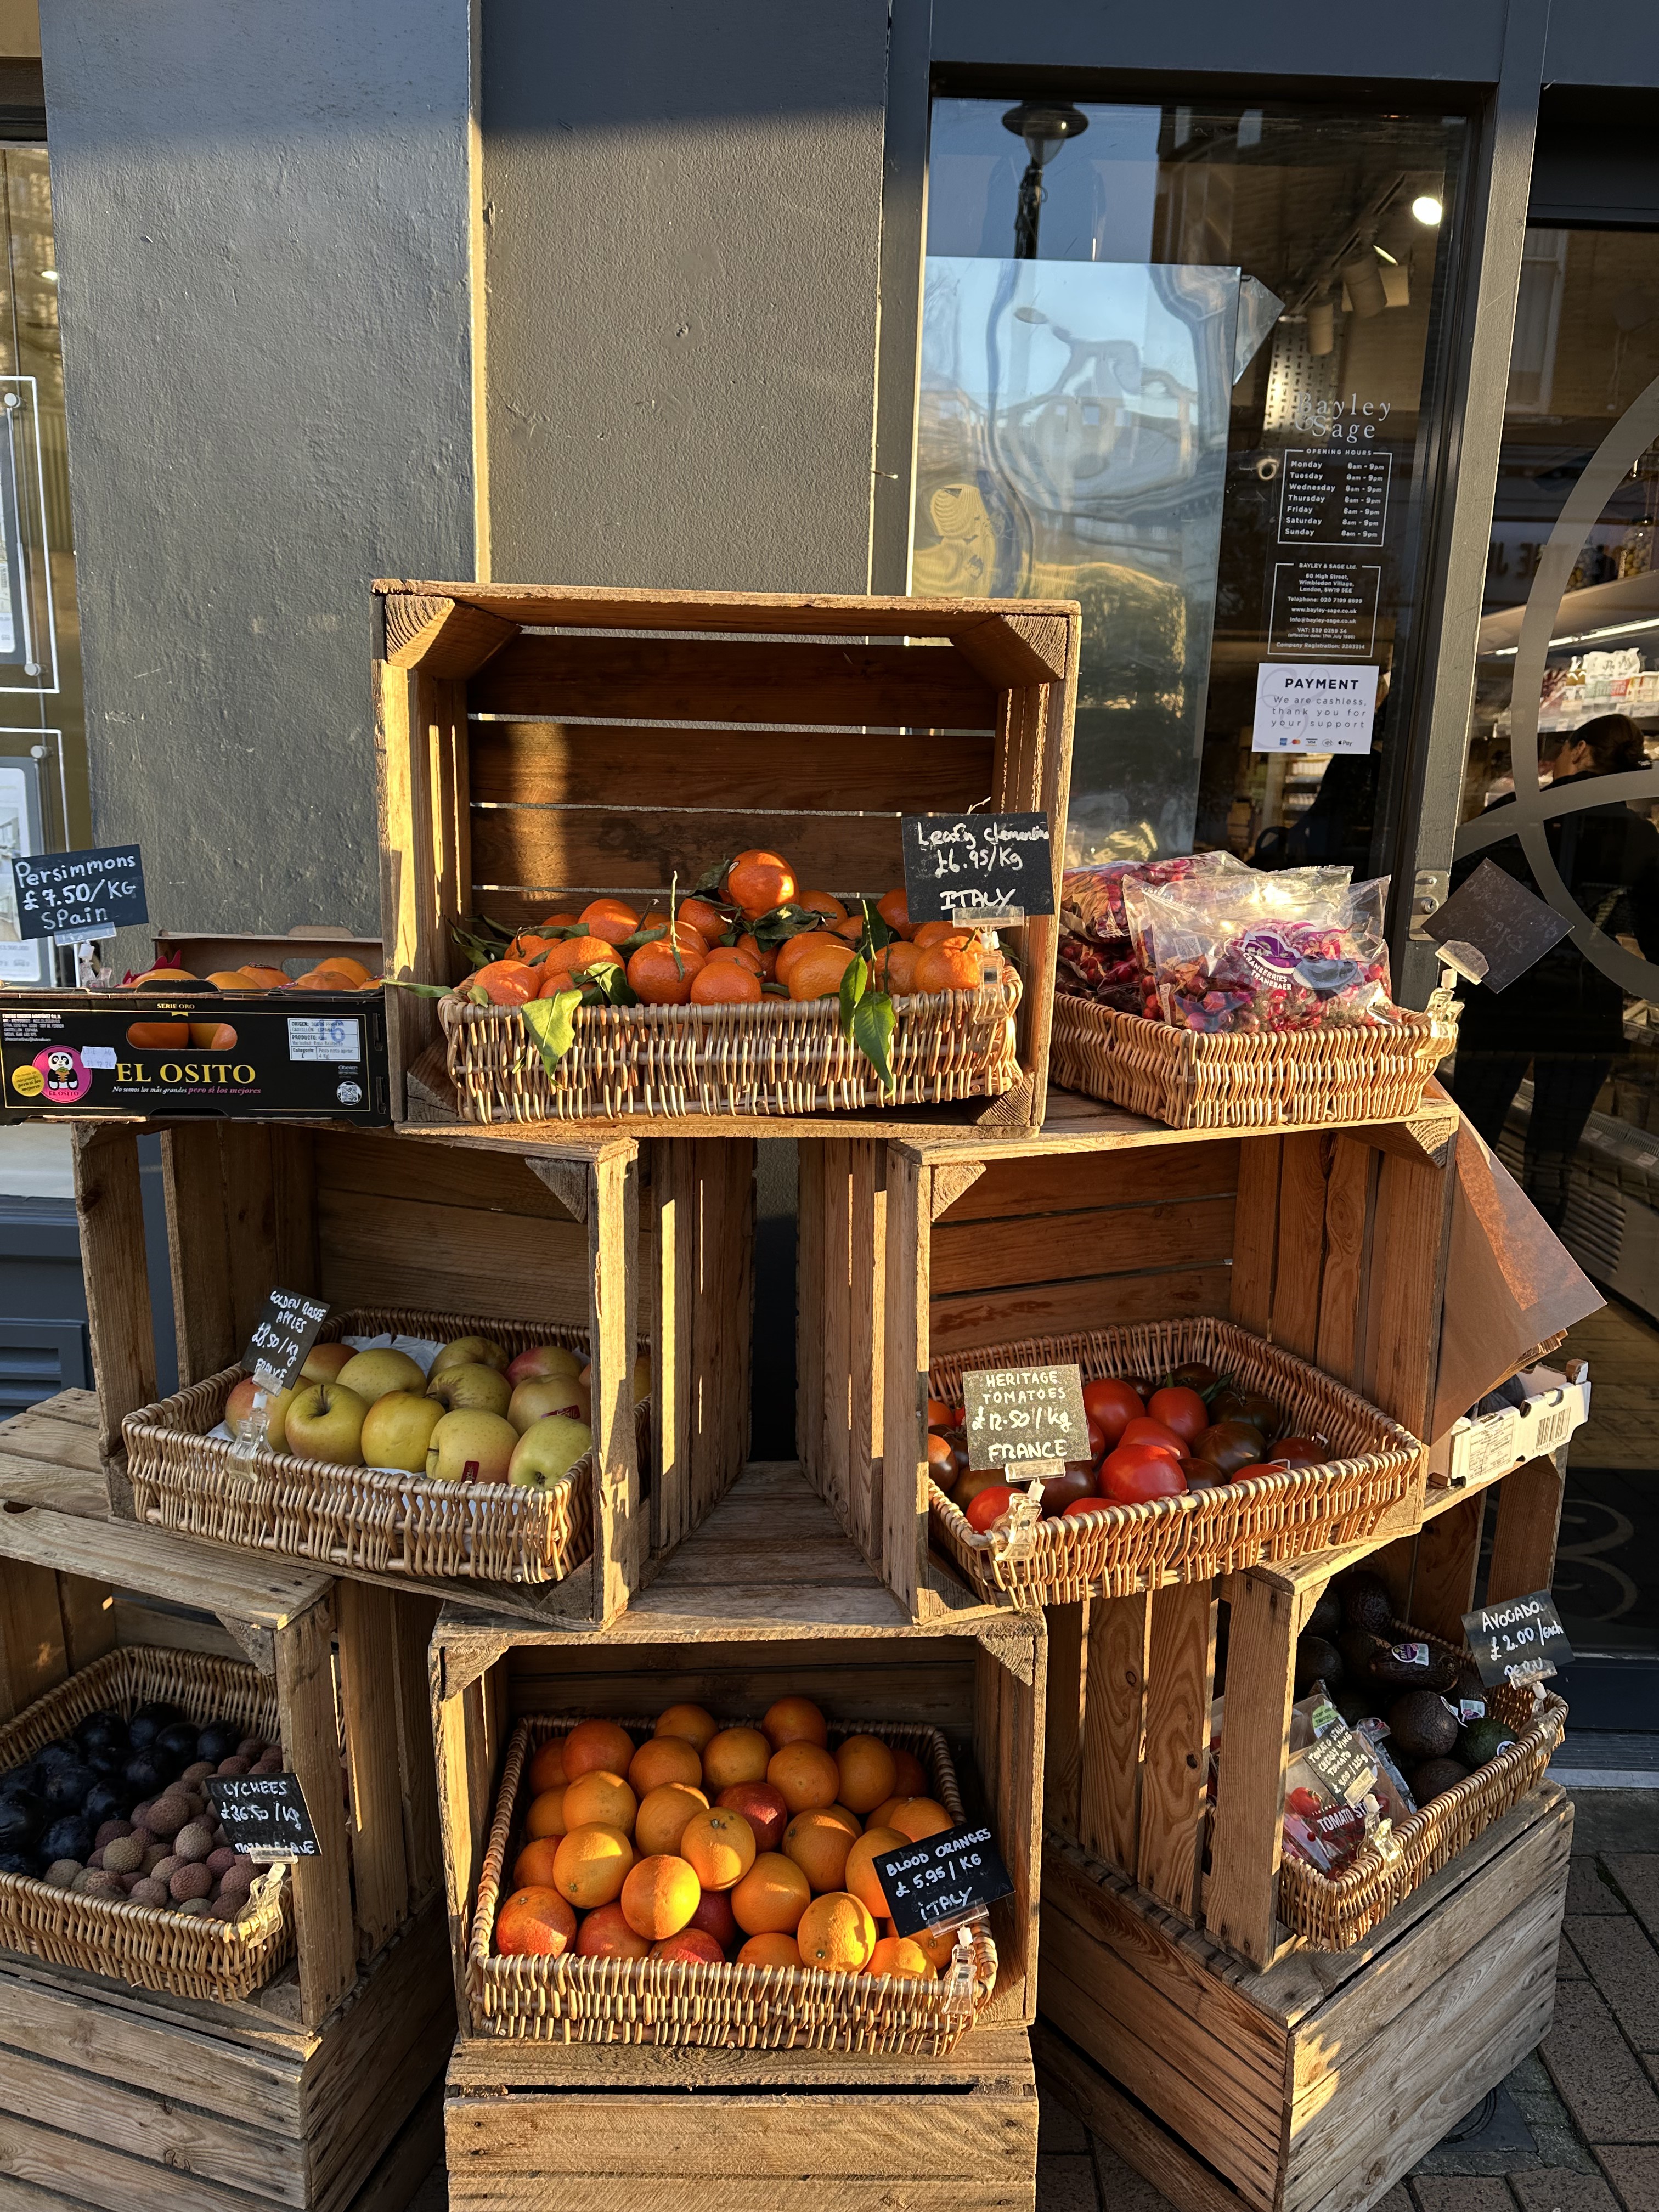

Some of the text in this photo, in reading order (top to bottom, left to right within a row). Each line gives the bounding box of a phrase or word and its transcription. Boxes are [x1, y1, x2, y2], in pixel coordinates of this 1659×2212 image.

[1298, 392, 1390, 421] Bayley
[1312, 416, 1375, 443] Sage
[1291, 461, 1322, 469] Monday
[1290, 483, 1335, 492] Wednesday
[1285, 679, 1359, 690] PAYMENT
[1274, 696, 1367, 707] We are cashless,
[1317, 709, 1338, 717] you
[917, 822, 977, 850] Leafy
[15, 855, 136, 888] Persimmons
[939, 888, 1016, 911] ITALY
[1243, 952, 1288, 983] CRANBERRIES
[1251, 970, 1291, 991] TRANEBAER
[116, 1063, 256, 1084] EL OSITO
[163, 1086, 187, 1094] grandes
[187, 1087, 206, 1096] pero
[230, 1087, 261, 1096] mejores
[270, 1290, 301, 1310] GOLDEN
[276, 1311, 307, 1333] APPLES
[986, 1371, 1057, 1388] HERITAGE
[983, 1387, 1066, 1404] TOMATOES
[988, 1439, 1067, 1462] FRANCE
[1308, 1724, 1346, 1763] TOMATO STALL
[1327, 1751, 1351, 1776] TOMATO
[223, 1781, 287, 1797] LYCHEES
[1317, 1808, 1355, 1832] TOMATO
[886, 1827, 991, 1877] BLOOD ORANGES
